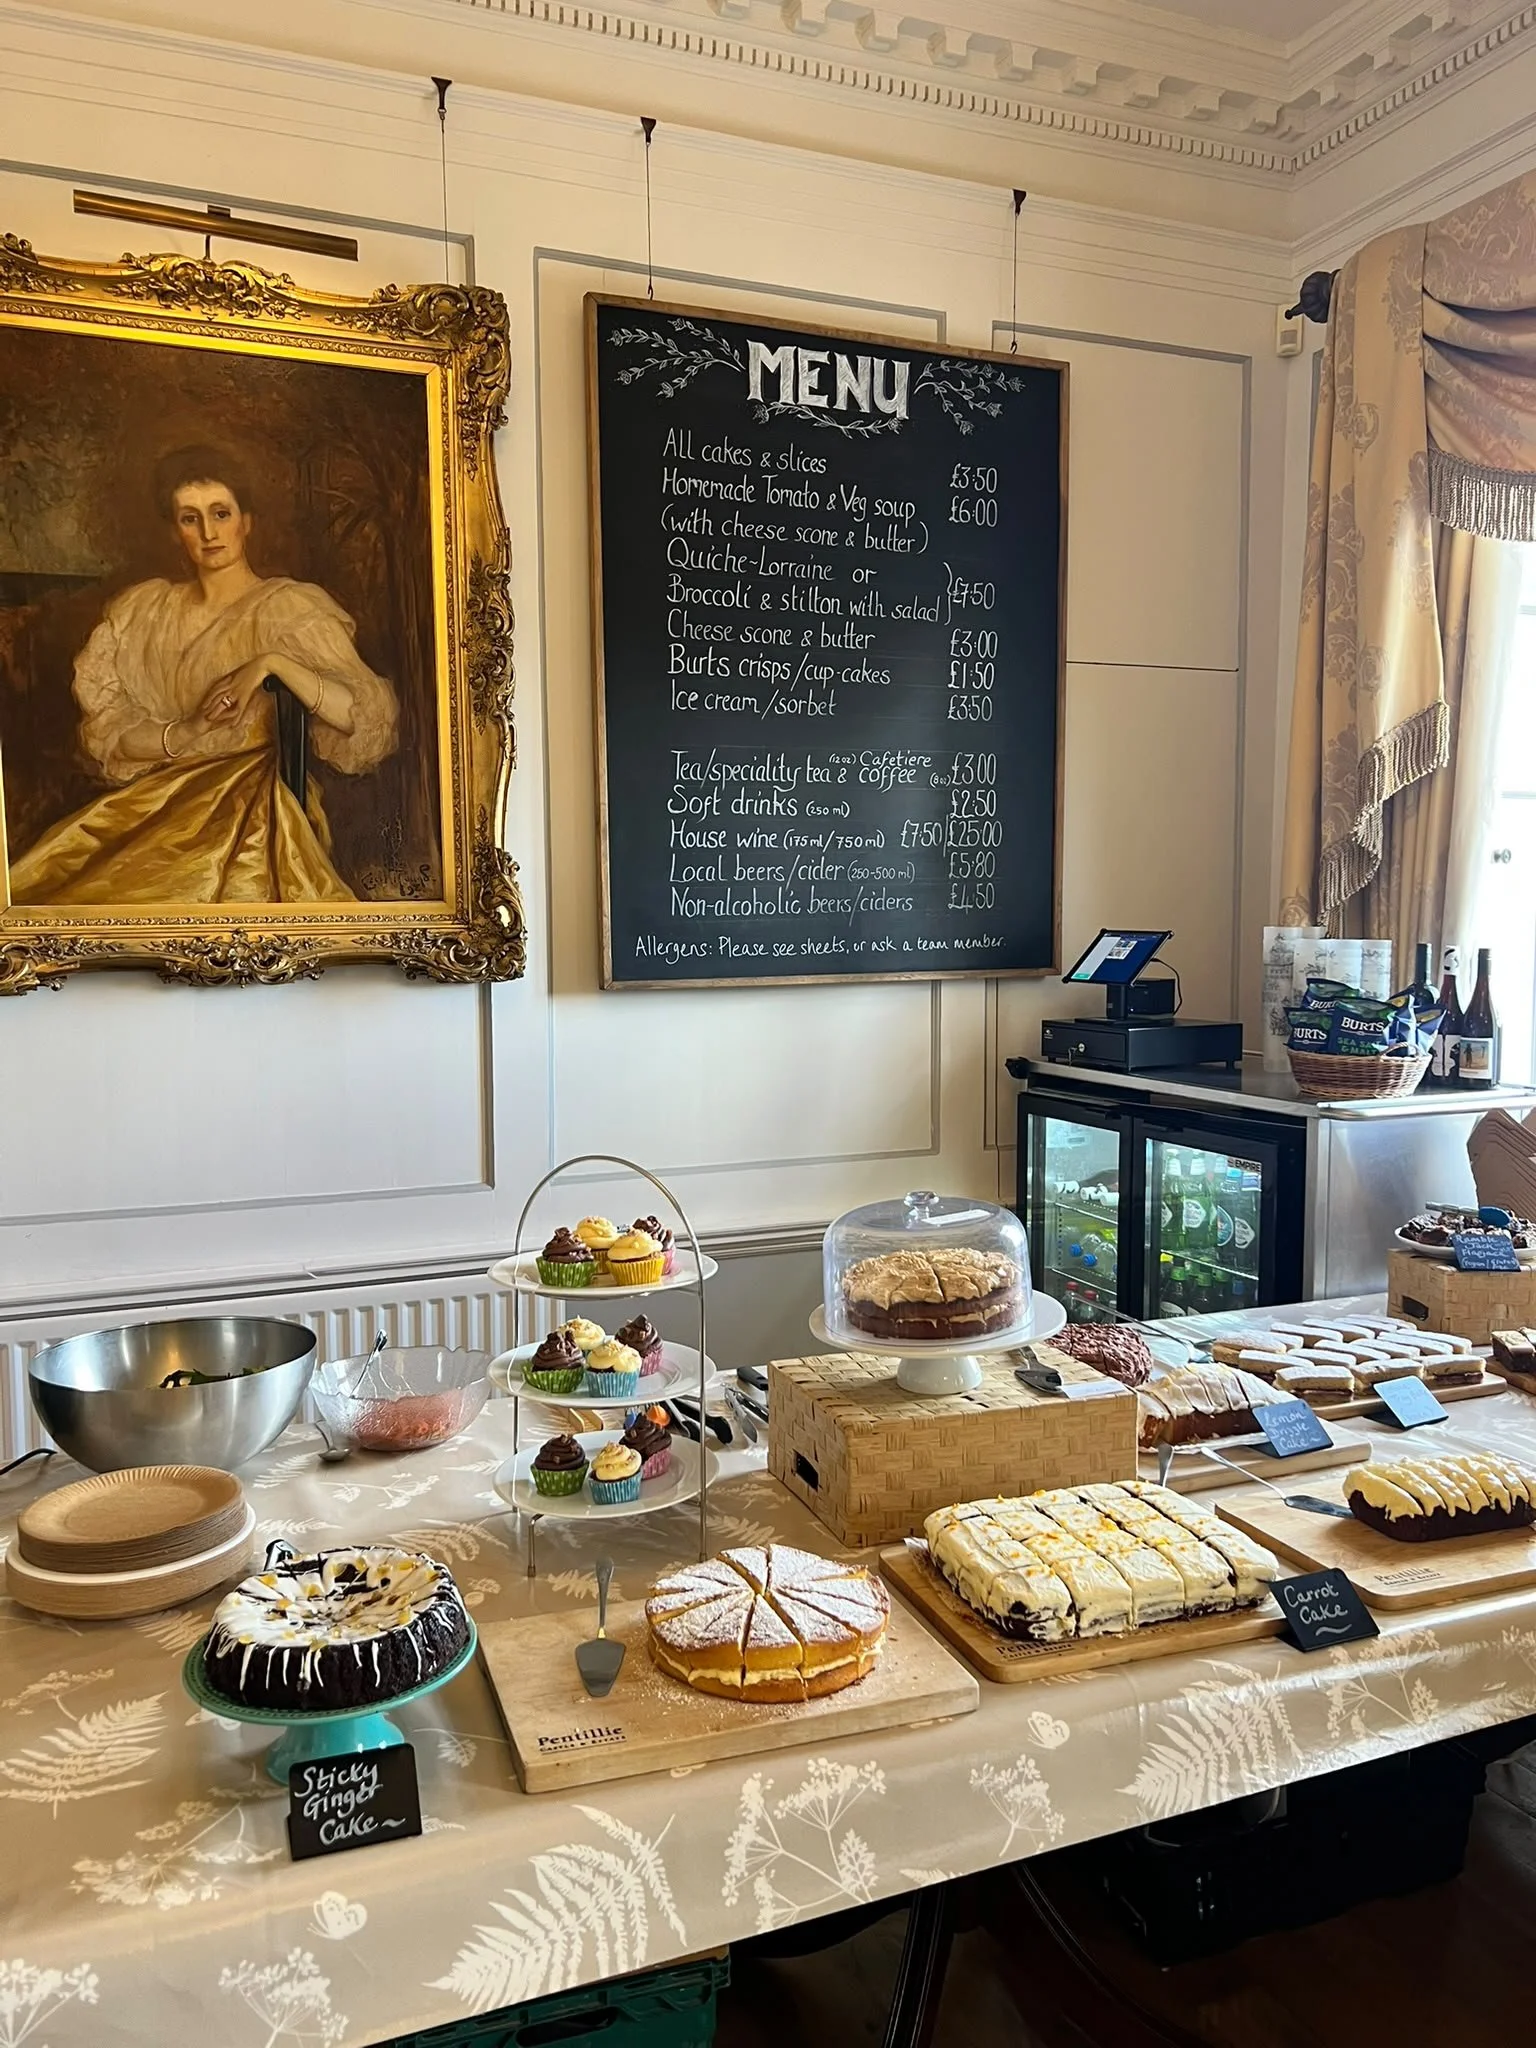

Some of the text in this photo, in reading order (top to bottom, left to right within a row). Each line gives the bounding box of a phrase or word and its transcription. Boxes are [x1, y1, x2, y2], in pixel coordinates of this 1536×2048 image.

[746, 339, 911, 420] MENU
[663, 427, 695, 460] All
[701, 436, 752, 466] cakes
[760, 451, 772, 468] &
[776, 443, 827, 474] slices
[662, 467, 756, 502] Homemade
[761, 474, 820, 509] Tomato
[826, 493, 837, 511] &
[840, 484, 867, 522] Veg
[874, 498, 916, 528] soup
[661, 503, 714, 536] (with
[721, 510, 788, 541] cheese
[794, 526, 839, 547] scone
[845, 531, 855, 547] &
[852, 568, 878, 584] or
[666, 573, 752, 609] Broccoli
[760, 593, 773, 611] &
[779, 584, 844, 616] stilton
[850, 590, 886, 618] with
[891, 595, 940, 622] salad
[667, 608, 736, 641] Cheese
[740, 626, 793, 646] scone
[800, 629, 813, 647] &
[820, 621, 876, 649] butter
[667, 643, 731, 677] Burts
[671, 679, 699, 711] Ice
[806, 754, 832, 783] tea
[859, 750, 932, 770] Cafetiere
[837, 767, 847, 784] &
[667, 784, 722, 824] Soft
[731, 786, 798, 817] drinks
[670, 819, 728, 849] House
[736, 827, 779, 849] wine
[669, 853, 728, 883] Local
[671, 886, 801, 918] Non-alcoholic
[635, 935, 712, 965] Allergens:
[718, 935, 769, 958] Please
[772, 943, 797, 958] see
[800, 935, 849, 956] sheets,
[853, 940, 866, 951] or
[871, 935, 897, 951] ask
[902, 940, 913, 951] a
[917, 936, 949, 950] team
[1309, 999, 1336, 1009] BURT
[1341, 1016, 1385, 1032] BURTS
[1235, 1160, 1261, 1172] EMPIRE
[1264, 1411, 1306, 1428] Lemon
[1268, 1422, 1310, 1440] Drizzle
[1279, 1436, 1307, 1450] Cake
[1283, 1581, 1339, 1608] Carrot
[1300, 1603, 1348, 1625] Cake
[538, 1727, 622, 1746] Pentillie
[294, 1762, 378, 1798] Sticky
[303, 1781, 384, 1820] Ginger
[319, 1812, 379, 1846] Cake
